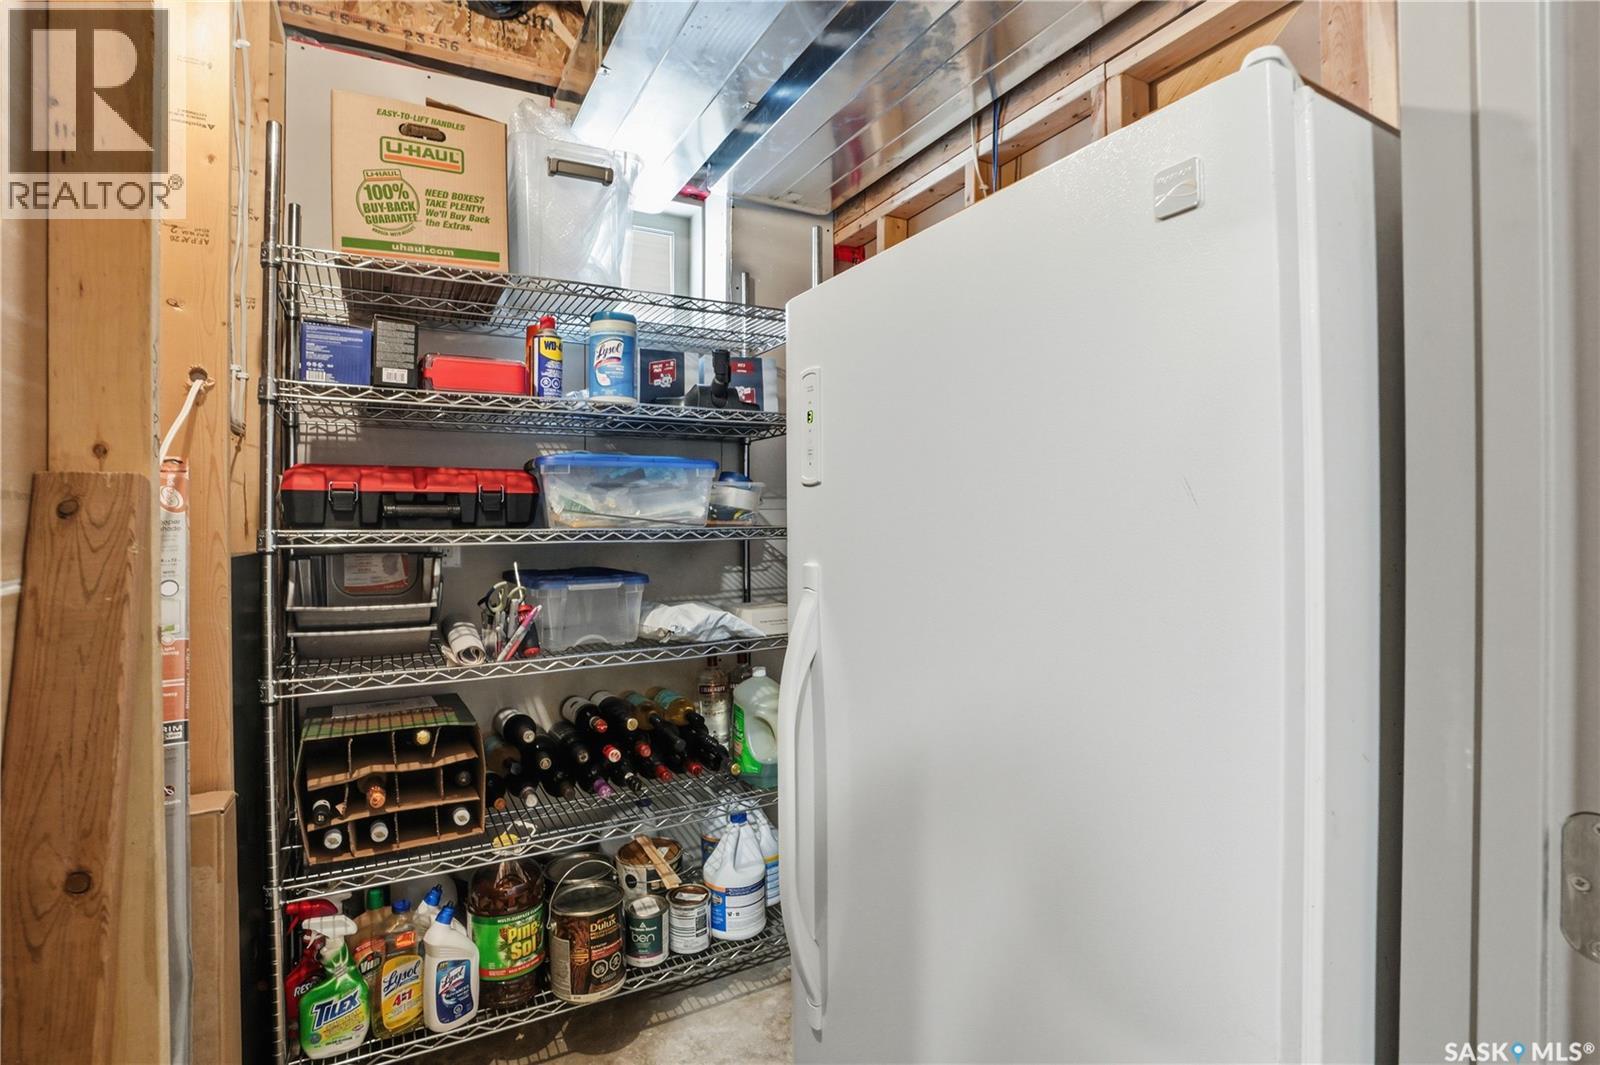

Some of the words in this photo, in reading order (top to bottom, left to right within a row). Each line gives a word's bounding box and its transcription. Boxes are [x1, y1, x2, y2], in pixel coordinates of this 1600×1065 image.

[403, 29, 460, 52] 23:56
[376, 107, 429, 123] EASY-TO-LIFT
[430, 117, 466, 131] HANDLES
[386, 141, 460, 164] U-HAUL
[363, 182, 410, 201] 100%
[425, 188, 449, 199] NEED
[451, 191, 485, 204] BOXES?
[362, 200, 417, 214] BUY-BACK
[426, 198, 449, 209] TAKE
[450, 201, 485, 214] PLENTY!
[365, 213, 417, 225] GUARANTEE
[426, 208, 448, 219] We'll
[450, 211, 467, 223] Buy
[468, 213, 491, 224] Back
[425, 218, 441, 227] the
[442, 220, 473, 231] Extras.
[391, 242, 455, 257] uhaul.com
[597, 342, 623, 359] Lysol
[590, 917, 617, 933] Dulux
[632, 930, 656, 943] ben
[383, 960, 421, 993] Lysol
[441, 966, 464, 988] Lysol
